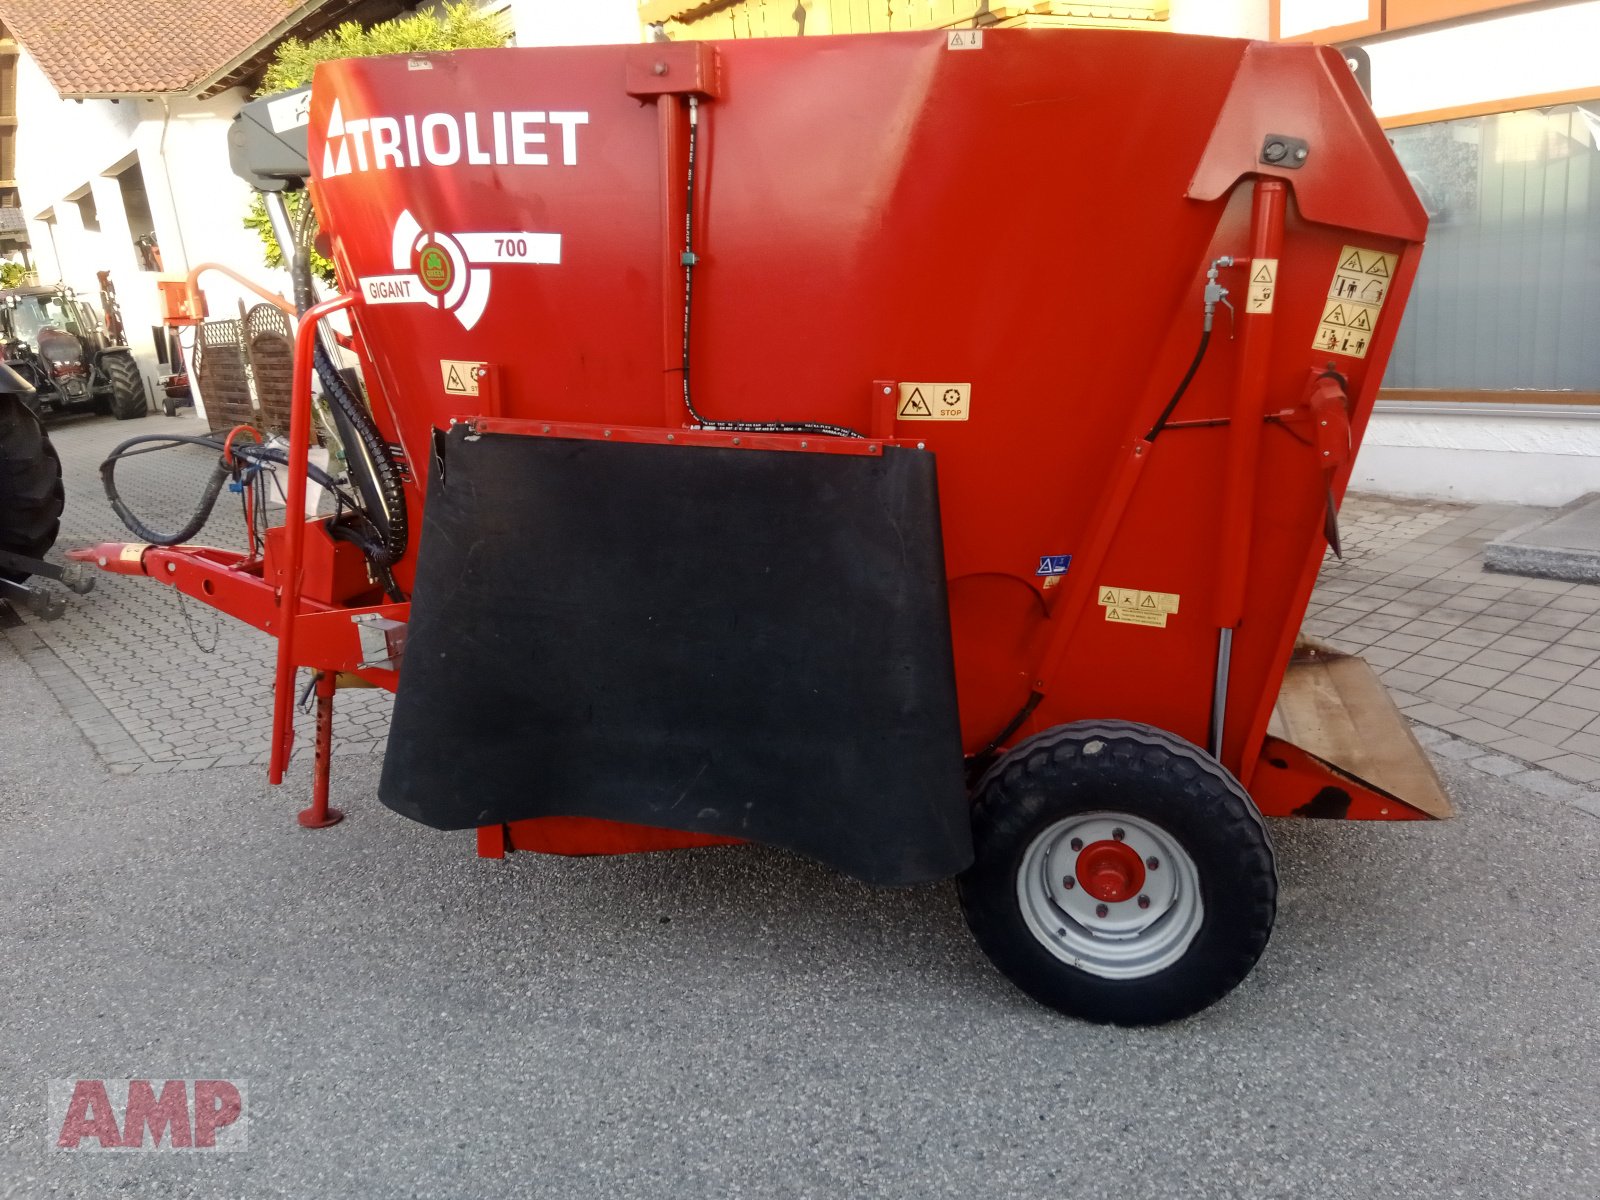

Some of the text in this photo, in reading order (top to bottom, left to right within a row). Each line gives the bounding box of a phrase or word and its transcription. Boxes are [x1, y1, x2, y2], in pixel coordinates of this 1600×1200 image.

[345, 111, 588, 172] TRIOLIET
[494, 238, 527, 257] 700
[368, 280, 411, 299] GIGANT
